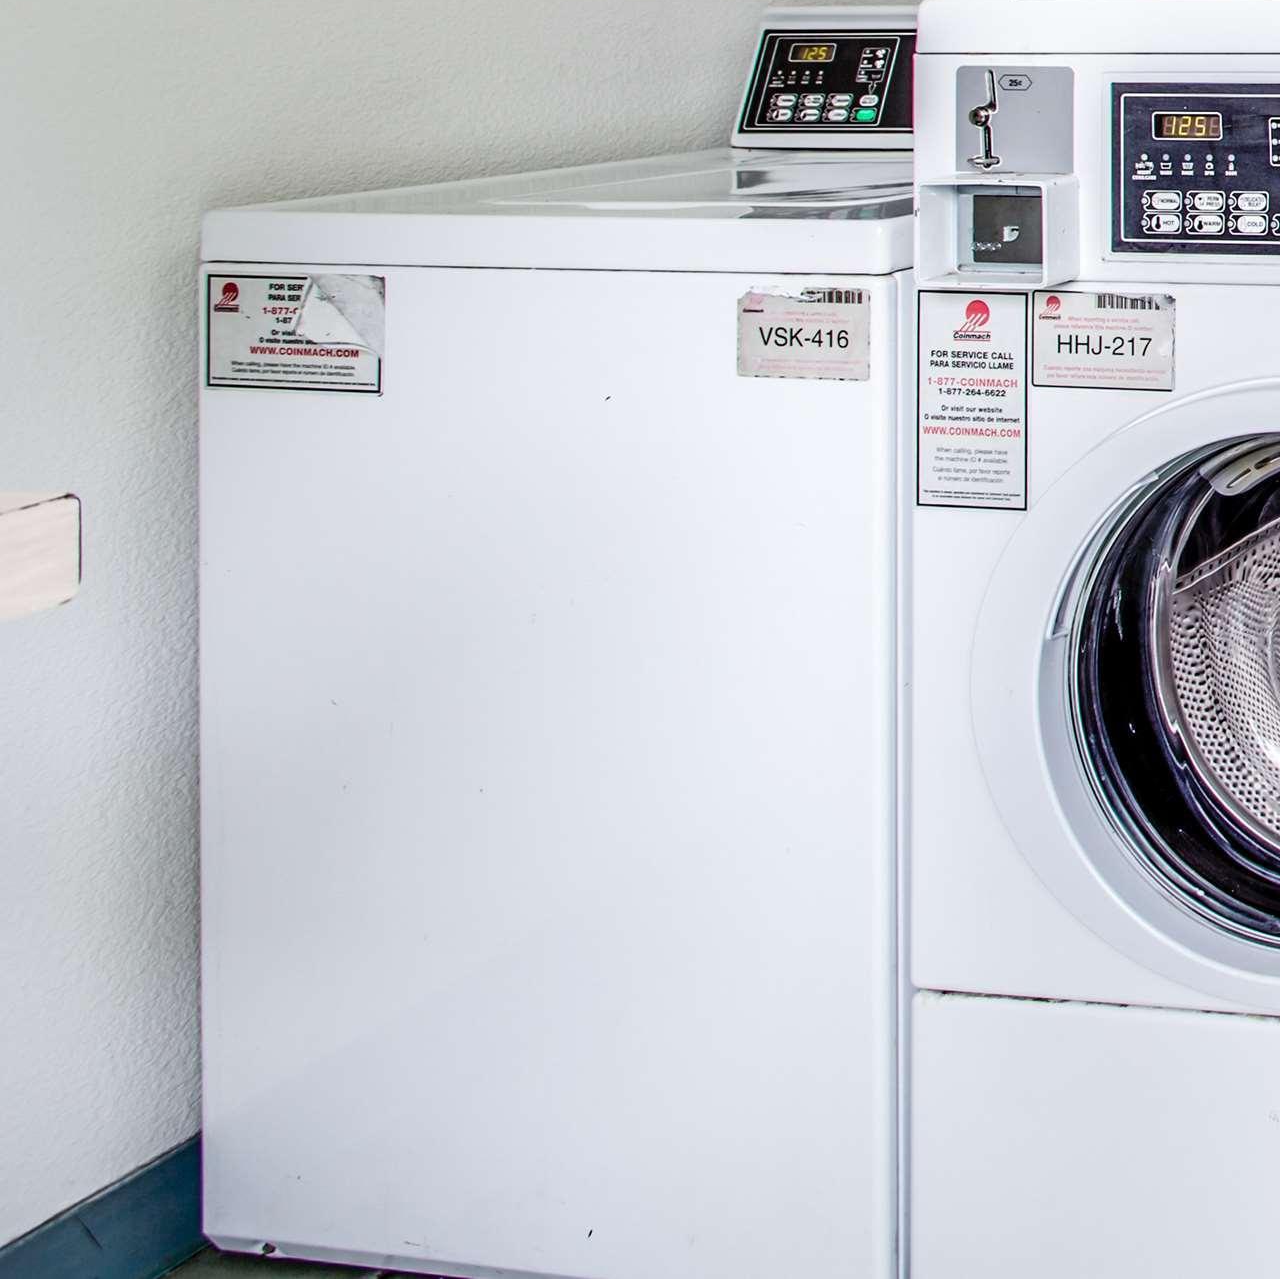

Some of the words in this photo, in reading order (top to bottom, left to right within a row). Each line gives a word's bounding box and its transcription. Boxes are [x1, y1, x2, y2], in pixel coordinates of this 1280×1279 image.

[801, 47, 828, 60] 125
[1170, 116, 1206, 136] 125
[269, 283, 286, 291] FOR
[759, 327, 849, 348] VSK-416
[953, 331, 991, 340] Coinmach
[1057, 334, 1152, 356] HHJ-217
[250, 346, 359, 358] WWW.COINMACH.COM
[931, 350, 949, 358] FOR
[951, 350, 988, 359] SERVICE
[991, 351, 1014, 360] CALL
[930, 360, 949, 368] PARA
[952, 361, 987, 369] SERVICIO
[988, 362, 1014, 370] LLAME
[927, 377, 1018, 388] 1-877-COINMACH
[938, 388, 1006, 397] 1-877-264-6622
[923, 426, 1021, 438] WWW.COINMACH.COM
